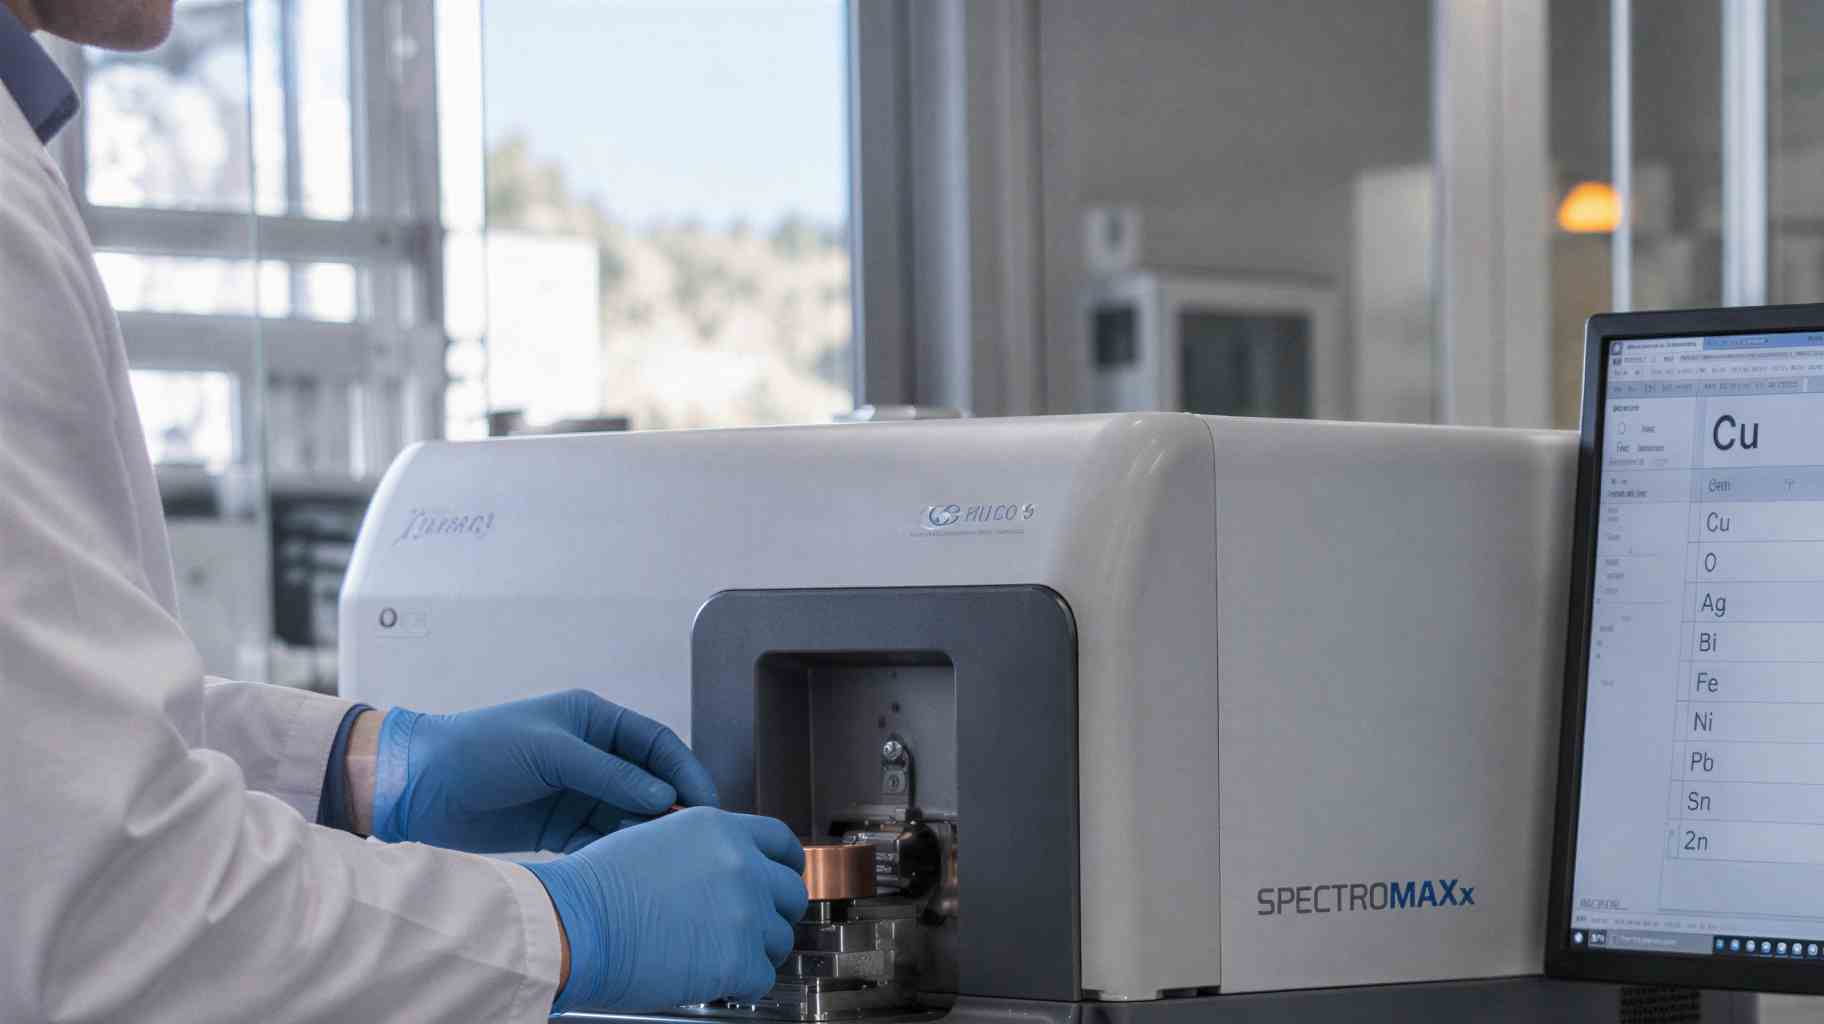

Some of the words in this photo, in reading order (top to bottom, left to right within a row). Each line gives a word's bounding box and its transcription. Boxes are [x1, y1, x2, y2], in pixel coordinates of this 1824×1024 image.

[1712, 414, 1760, 451] Cu
[1706, 511, 1731, 533] Cu
[1700, 592, 1727, 618] Ag
[1699, 631, 1717, 653] Bi
[1696, 671, 1719, 694] Fe
[1693, 711, 1713, 733] Ni
[1690, 751, 1714, 773] Pb
[1687, 791, 1711, 812] Sn
